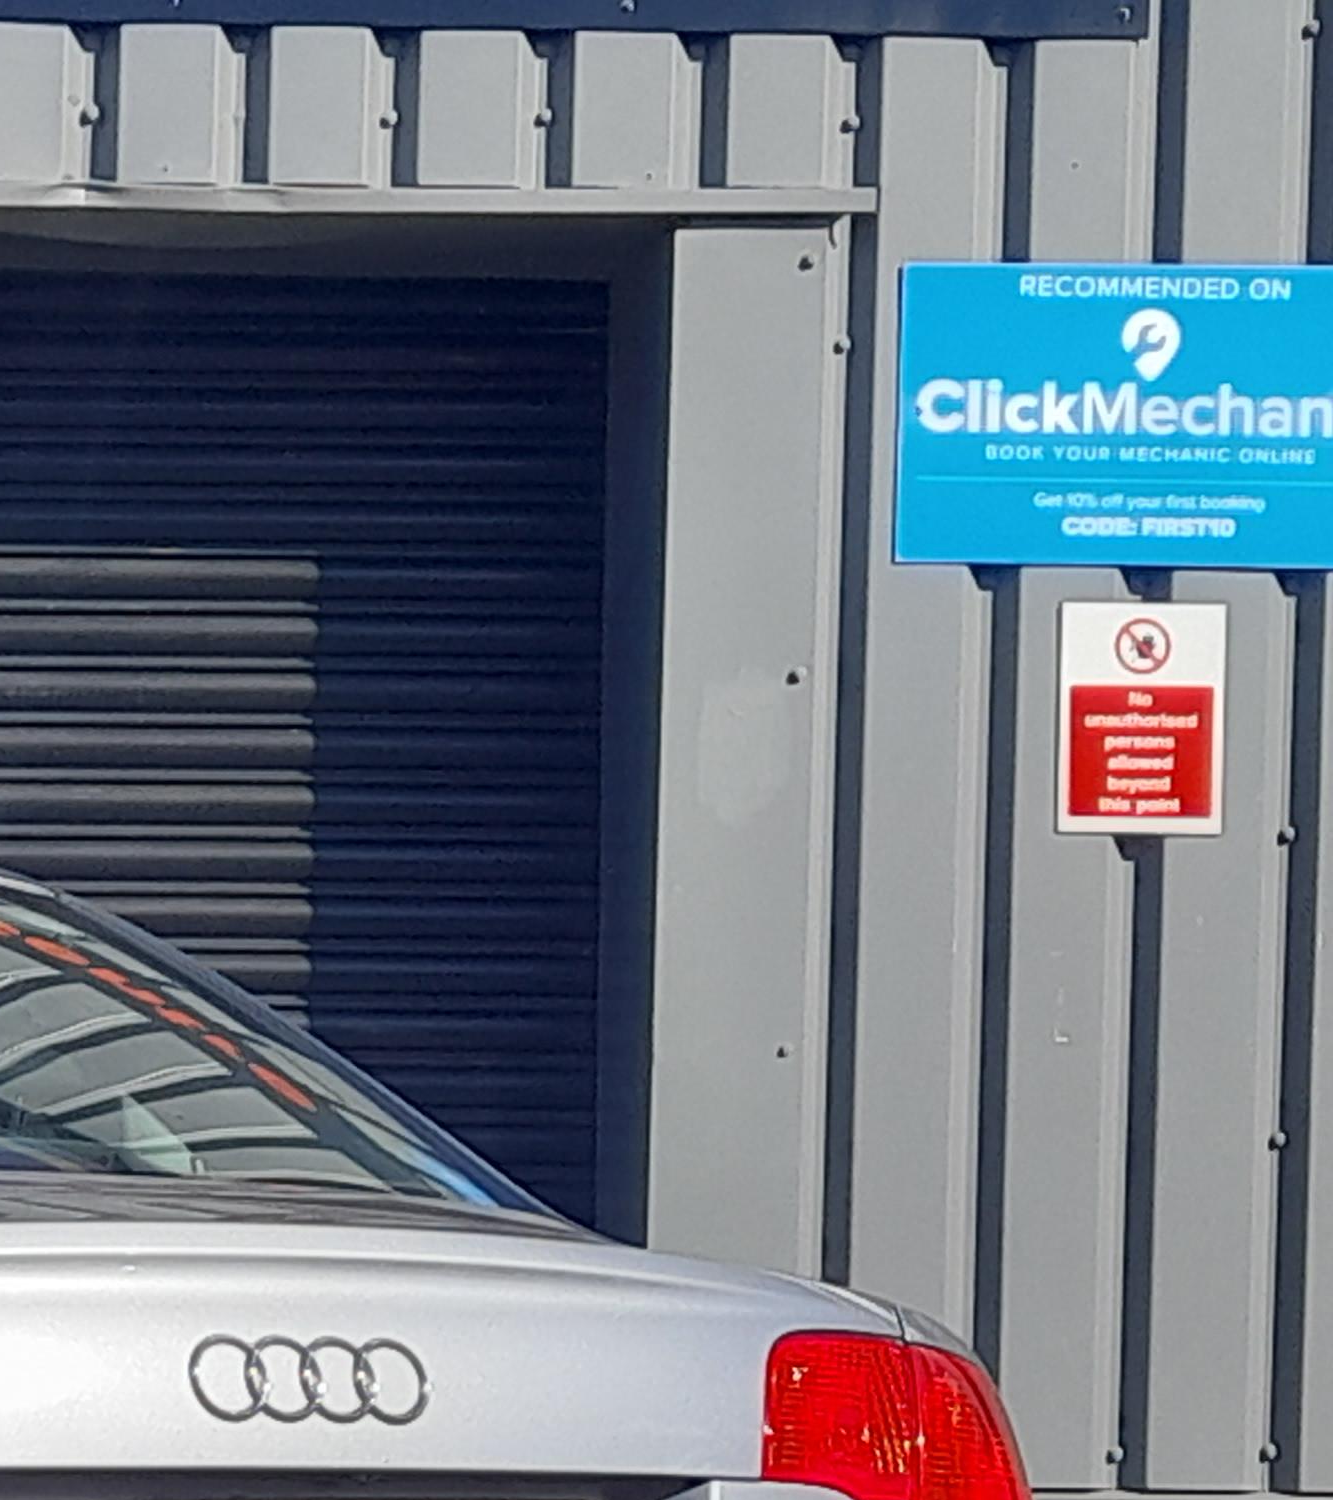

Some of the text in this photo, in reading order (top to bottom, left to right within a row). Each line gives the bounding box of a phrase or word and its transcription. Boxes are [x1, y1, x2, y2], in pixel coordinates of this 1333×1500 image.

[1019, 274, 1292, 300] RECOMMENDED ON
[985, 445, 1315, 465] BOOK YOUR MECHANIC ONLINE
[1034, 492, 1266, 514] Get 10% off your first booking
[1061, 516, 1237, 538] CODE: FIRST10
[1128, 691, 1153, 707] No
